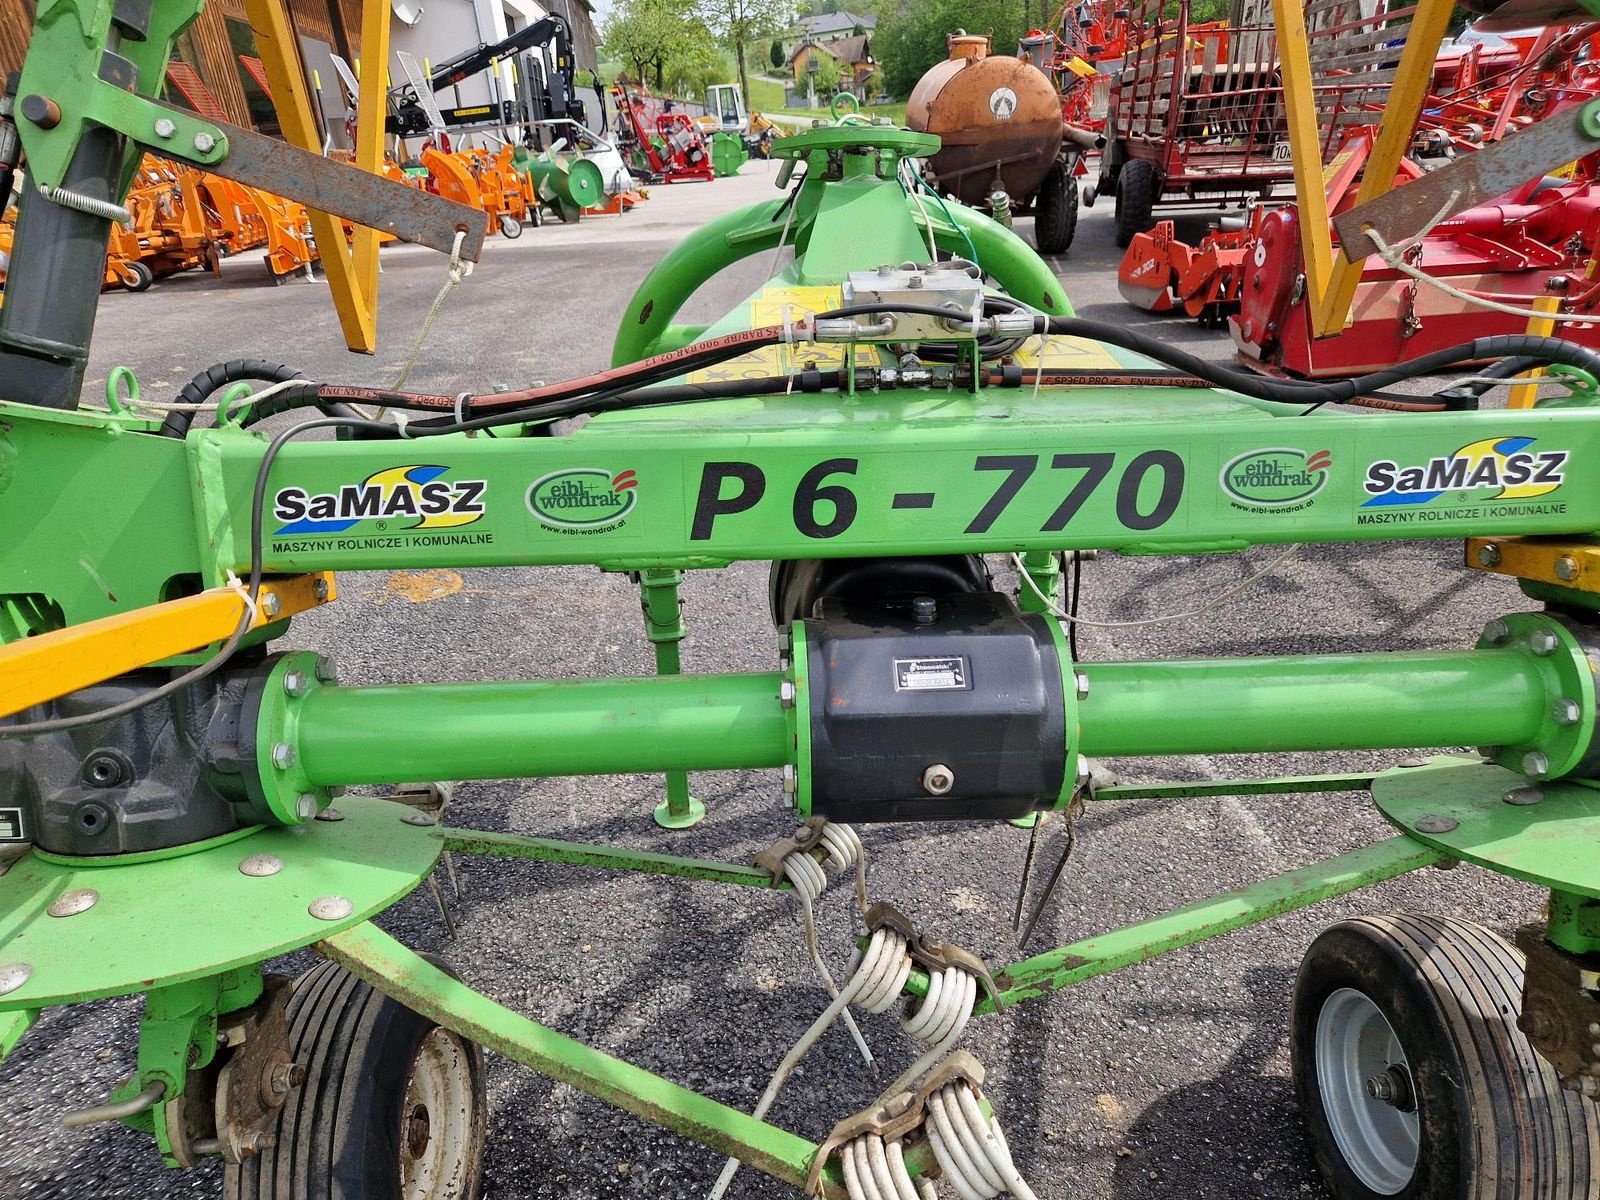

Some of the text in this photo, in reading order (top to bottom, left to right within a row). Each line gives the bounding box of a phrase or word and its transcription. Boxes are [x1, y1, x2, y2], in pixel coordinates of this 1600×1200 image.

[700, 340, 719, 350] 900
[1088, 376, 1109, 384] PRO
[417, 395, 435, 405] PRO
[1233, 470, 1312, 487] wondrak
[1364, 451, 1569, 494] SaMASZ
[540, 490, 621, 509] wondrak
[963, 449, 1185, 534] 770
[275, 481, 486, 522] SaMASZ
[1231, 499, 1314, 514] www.eibl-wondrak.at
[1357, 511, 1415, 525] MASZYNY
[1418, 507, 1479, 522] ROLNICZE
[1490, 503, 1566, 517] KOMUNALNE
[540, 519, 626, 535] www.eibl-wondrak.at
[272, 541, 332, 553] MASZYNY
[337, 537, 401, 550] ROLNICZE
[413, 533, 493, 547] KOMUNALNE
